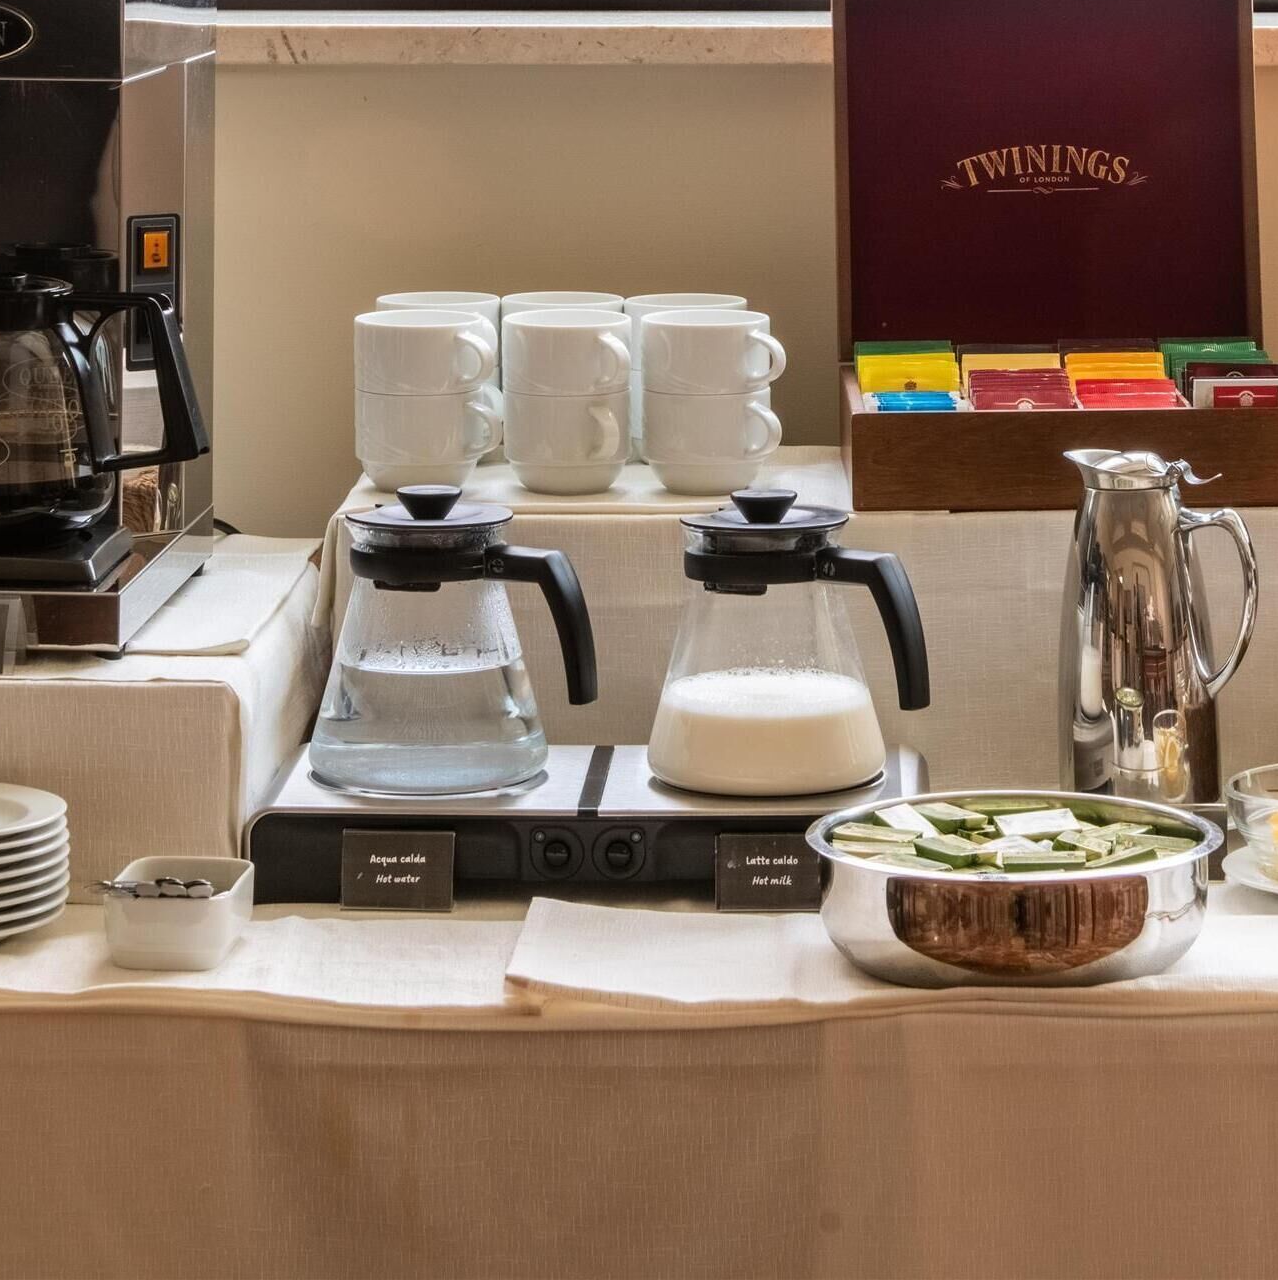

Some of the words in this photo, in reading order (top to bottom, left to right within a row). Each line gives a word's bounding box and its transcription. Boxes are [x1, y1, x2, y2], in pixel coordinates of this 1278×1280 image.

[957, 144, 1130, 187] TWININGS
[370, 854, 397, 867] Acqua
[400, 853, 426, 863] calda
[746, 855, 770, 865] Latte
[772, 855, 798, 865] caldo
[375, 874, 392, 884] Hot
[393, 874, 421, 883] water
[752, 876, 769, 886] Hot
[770, 875, 793, 886] milk
